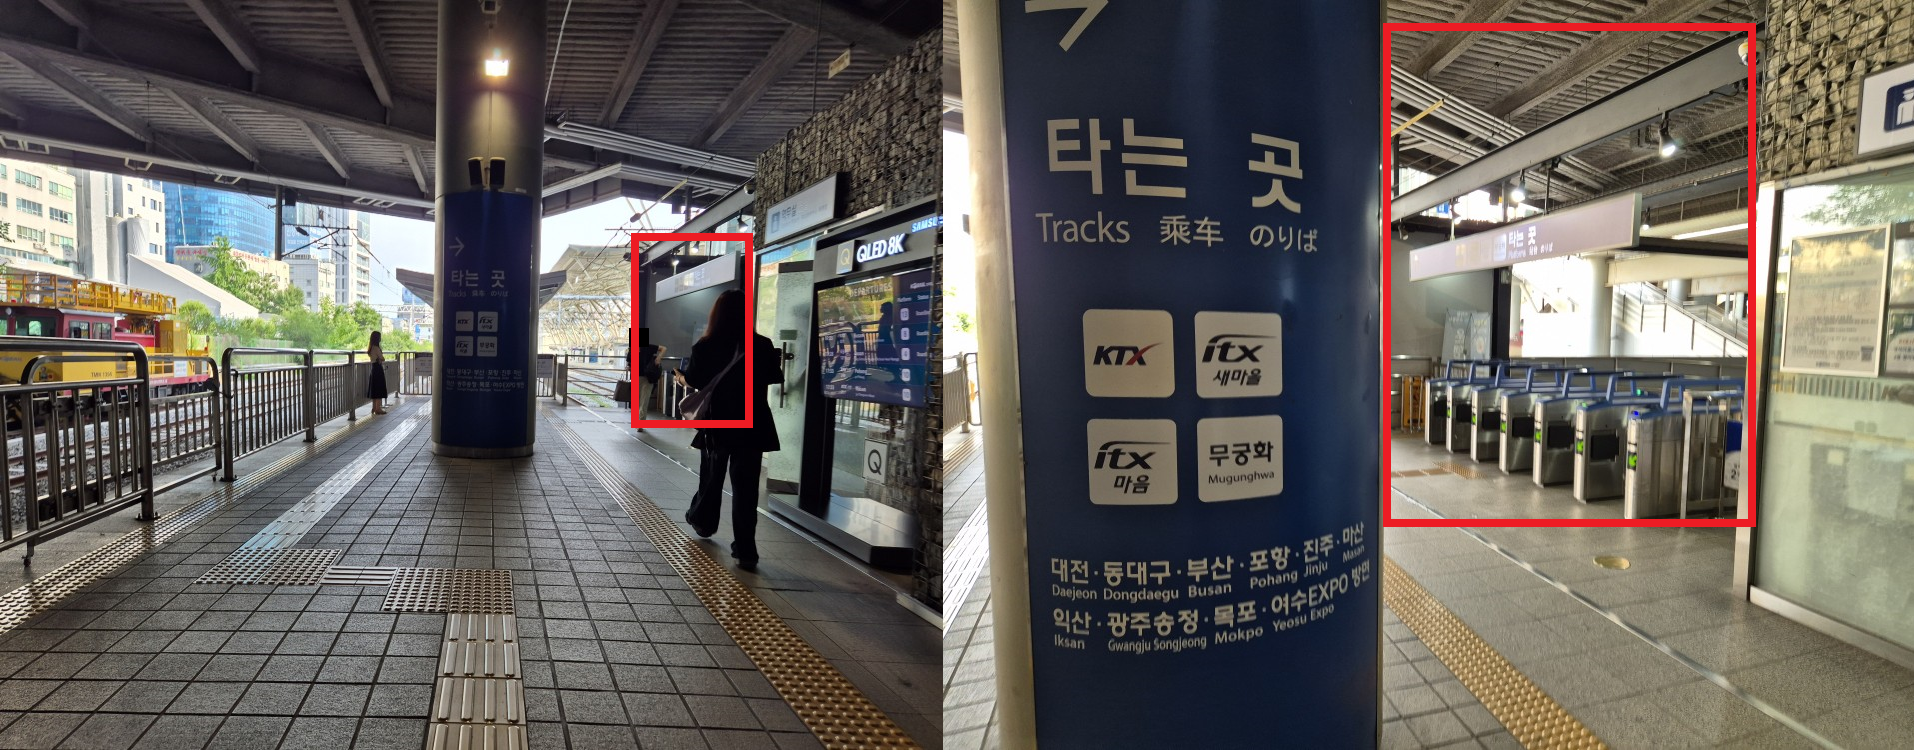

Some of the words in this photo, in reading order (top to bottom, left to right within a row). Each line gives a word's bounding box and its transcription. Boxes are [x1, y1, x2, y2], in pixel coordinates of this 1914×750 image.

[1047, 118, 1188, 198] 타는
[1248, 132, 1304, 214] 곳
[1035, 211, 1131, 244] Tracks
[840, 248, 850, 266] Q
[856, 239, 887, 263] QLED
[887, 233, 906, 256] 8K
[451, 269, 479, 287] 타는
[490, 270, 506, 288] 곳
[1093, 343, 1164, 366] KTX
[1213, 368, 1262, 387] 새마을
[868, 449, 882, 475] Q
[1209, 440, 1274, 467] 무궁화
[1113, 474, 1150, 494] 마음
[1208, 470, 1275, 485] Mugunghwa
[1051, 557, 1089, 584] 대전
[1104, 561, 1171, 587] 동대구
[1187, 555, 1234, 583] 부산
[1249, 545, 1291, 572] 포항
[1303, 533, 1334, 563] 진주
[1342, 521, 1365, 547] 마산
[1052, 584, 1098, 601] Daejeon
[1103, 588, 1179, 604] Dongdaegu
[1188, 583, 1232, 598] Busan
[1250, 570, 1298, 590] Pohang
[1303, 561, 1328, 578] Jinju
[1342, 544, 1365, 564] Masan
[1053, 608, 1092, 636] 익산
[1107, 608, 1199, 637] 광주송정
[1213, 600, 1257, 628] 목포
[1271, 572, 1349, 617] 여수EXPO
[1054, 634, 1085, 650] Iksan
[1107, 639, 1151, 655] Gwangju
[1153, 636, 1207, 653] Songjeong
[1214, 625, 1264, 645] Mokpo
[1272, 612, 1307, 632] Yeosu
[1310, 603, 1335, 622] Expo
